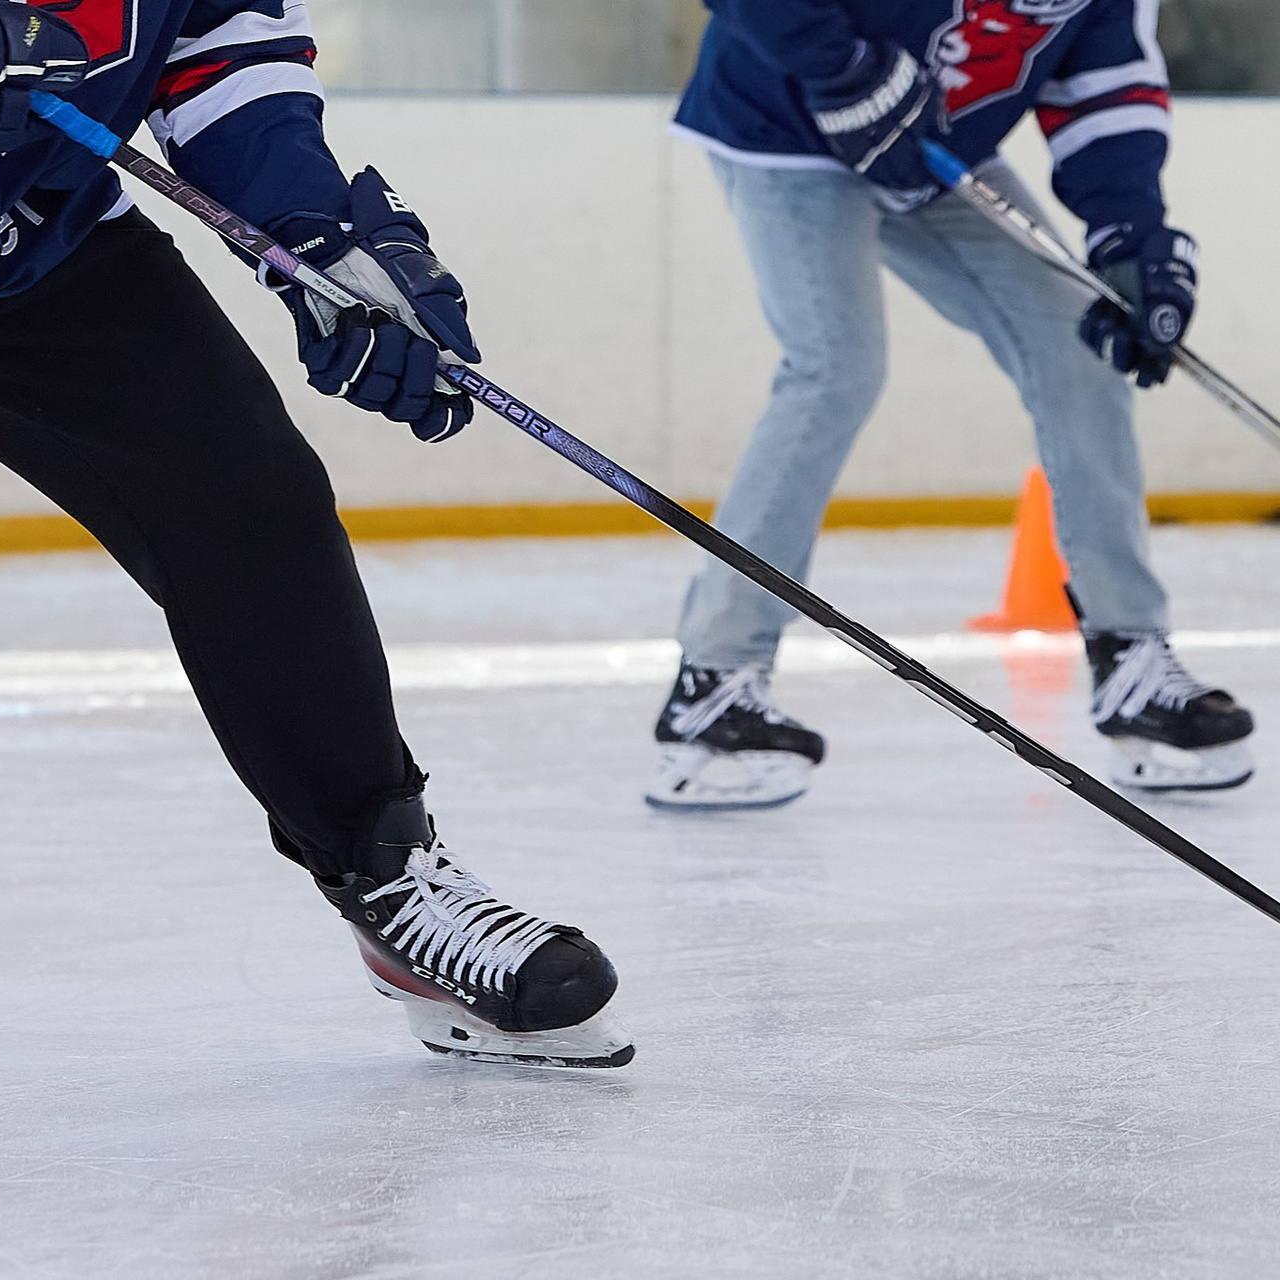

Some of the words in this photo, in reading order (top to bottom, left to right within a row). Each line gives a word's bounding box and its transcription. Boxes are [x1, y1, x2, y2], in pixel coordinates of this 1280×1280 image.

[290, 236, 325, 255] AUER
[460, 371, 551, 438] BCOR
[411, 964, 478, 1006] CCM
